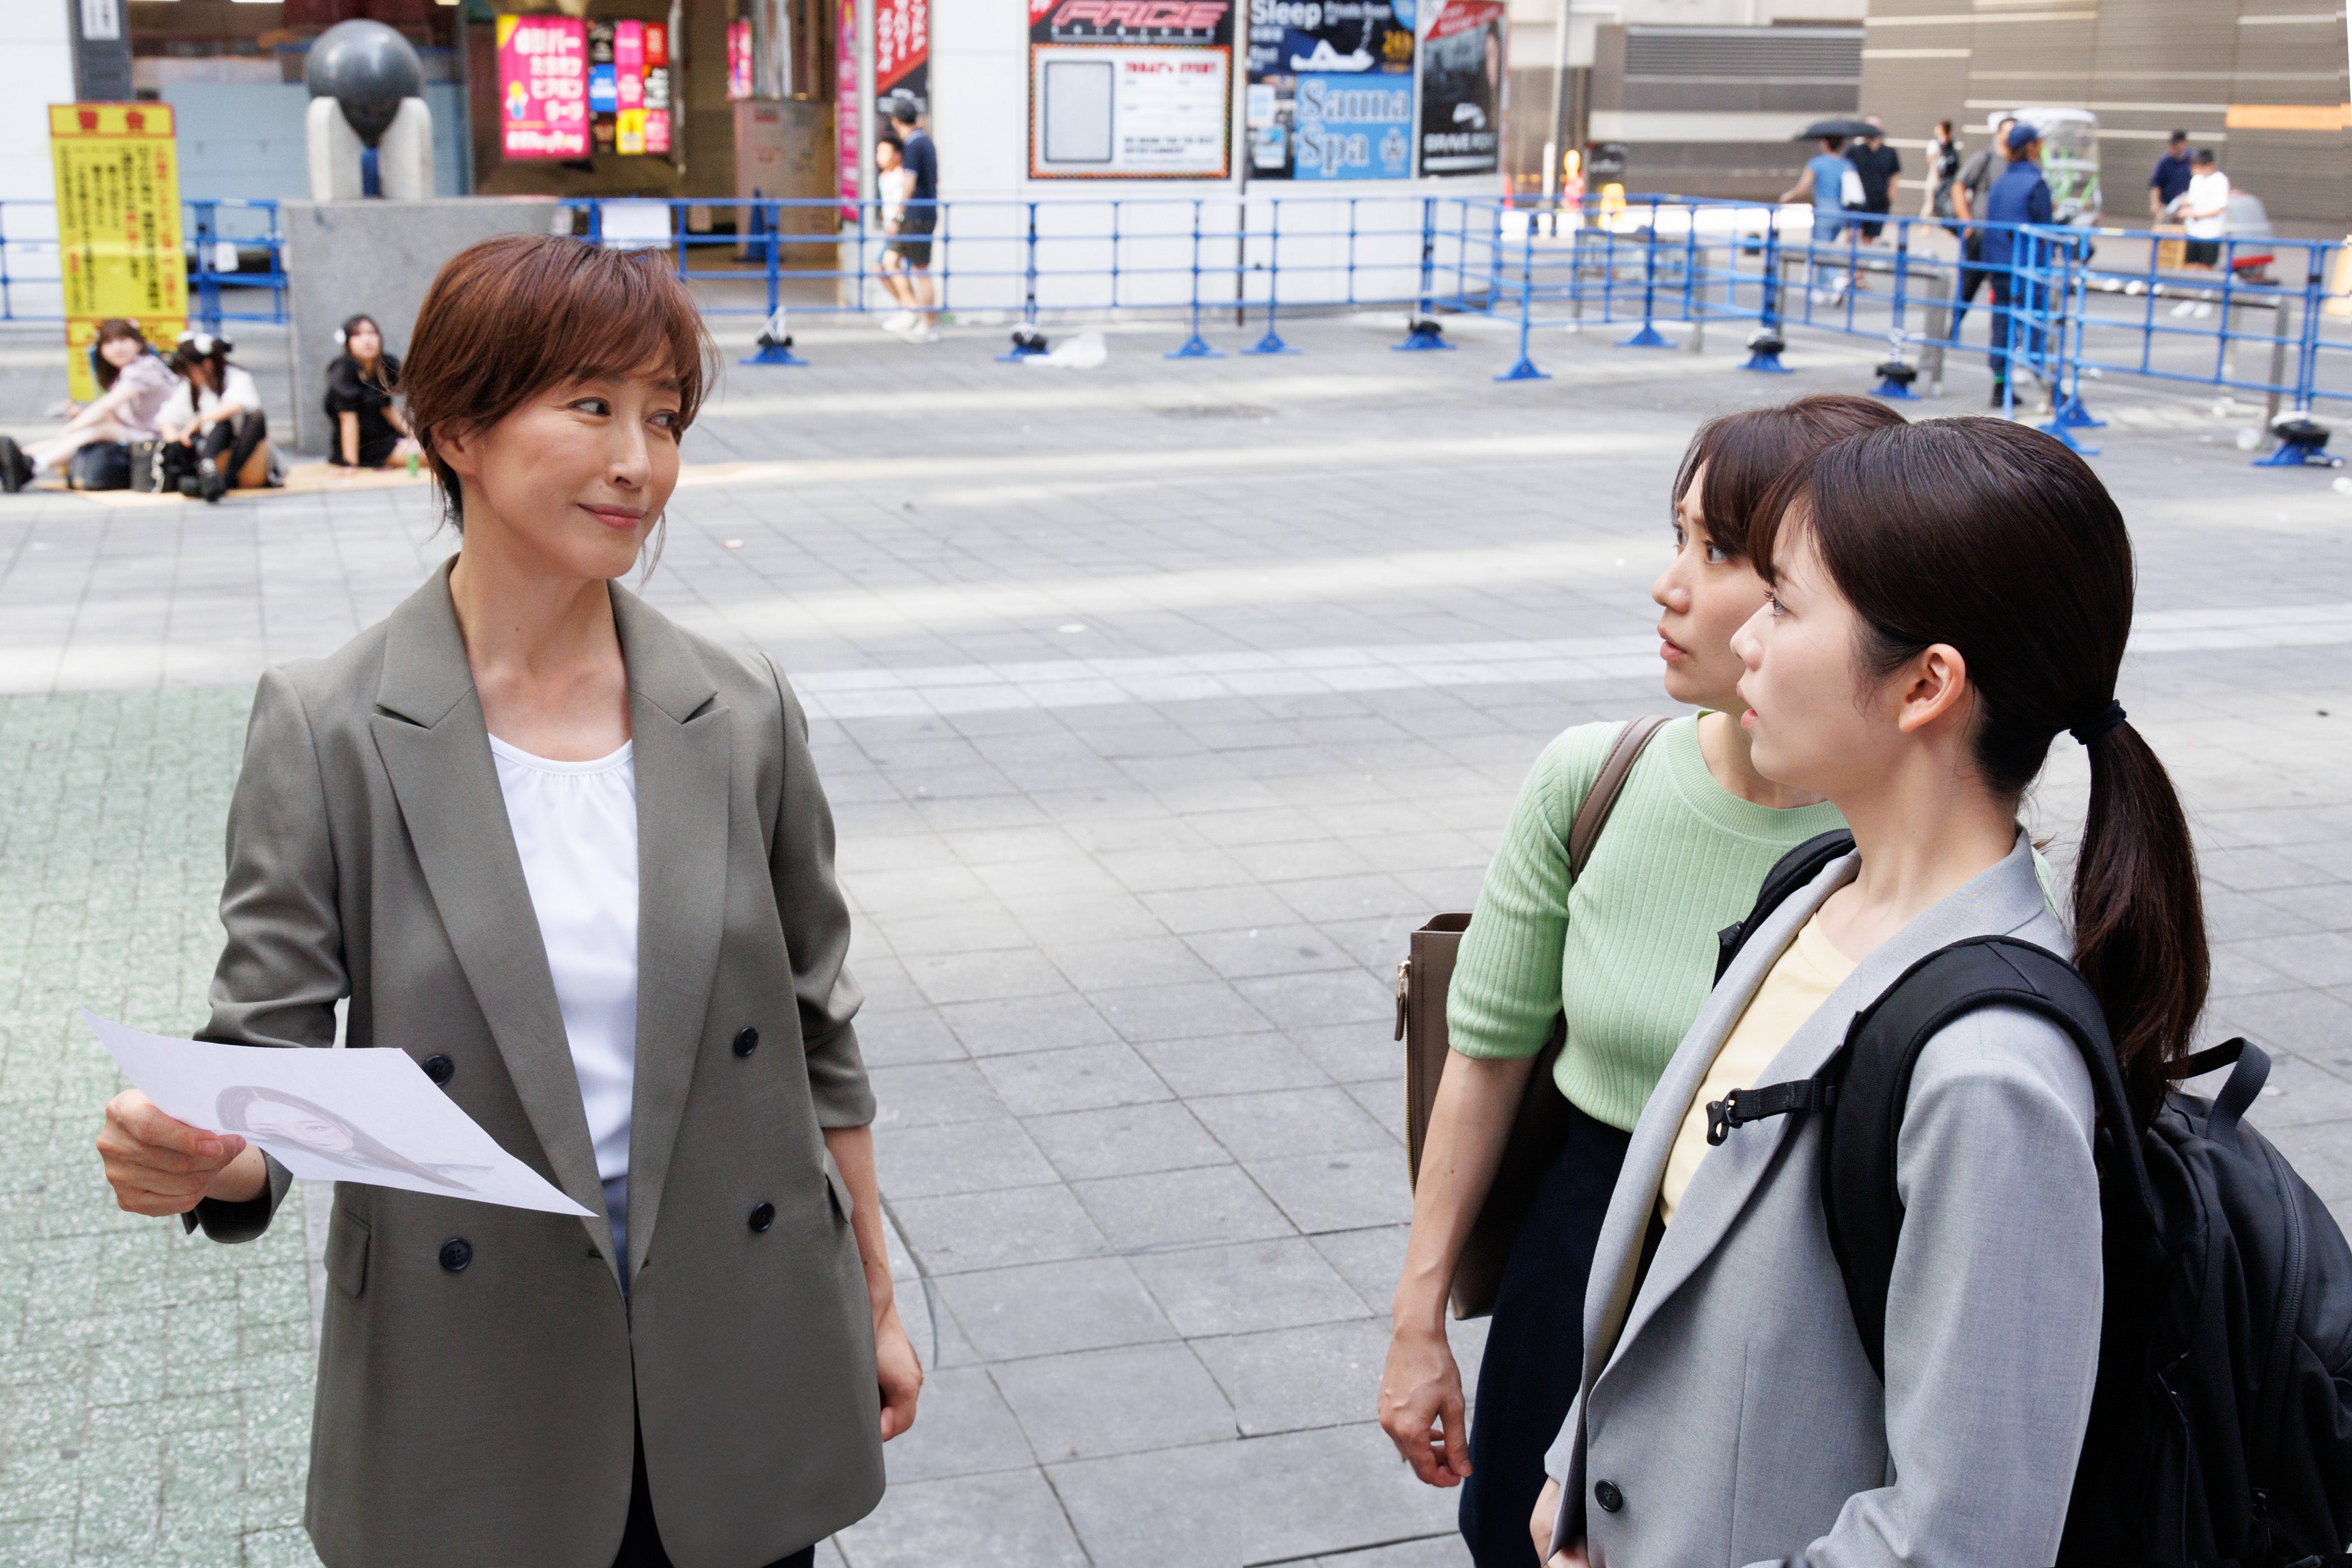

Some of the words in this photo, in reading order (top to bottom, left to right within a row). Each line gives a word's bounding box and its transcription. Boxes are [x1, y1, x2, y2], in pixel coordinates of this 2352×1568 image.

[1250, 0, 1322, 30] Sleep
[1300, 79, 1411, 123] Sauna
[1298, 123, 1369, 177] Spa
